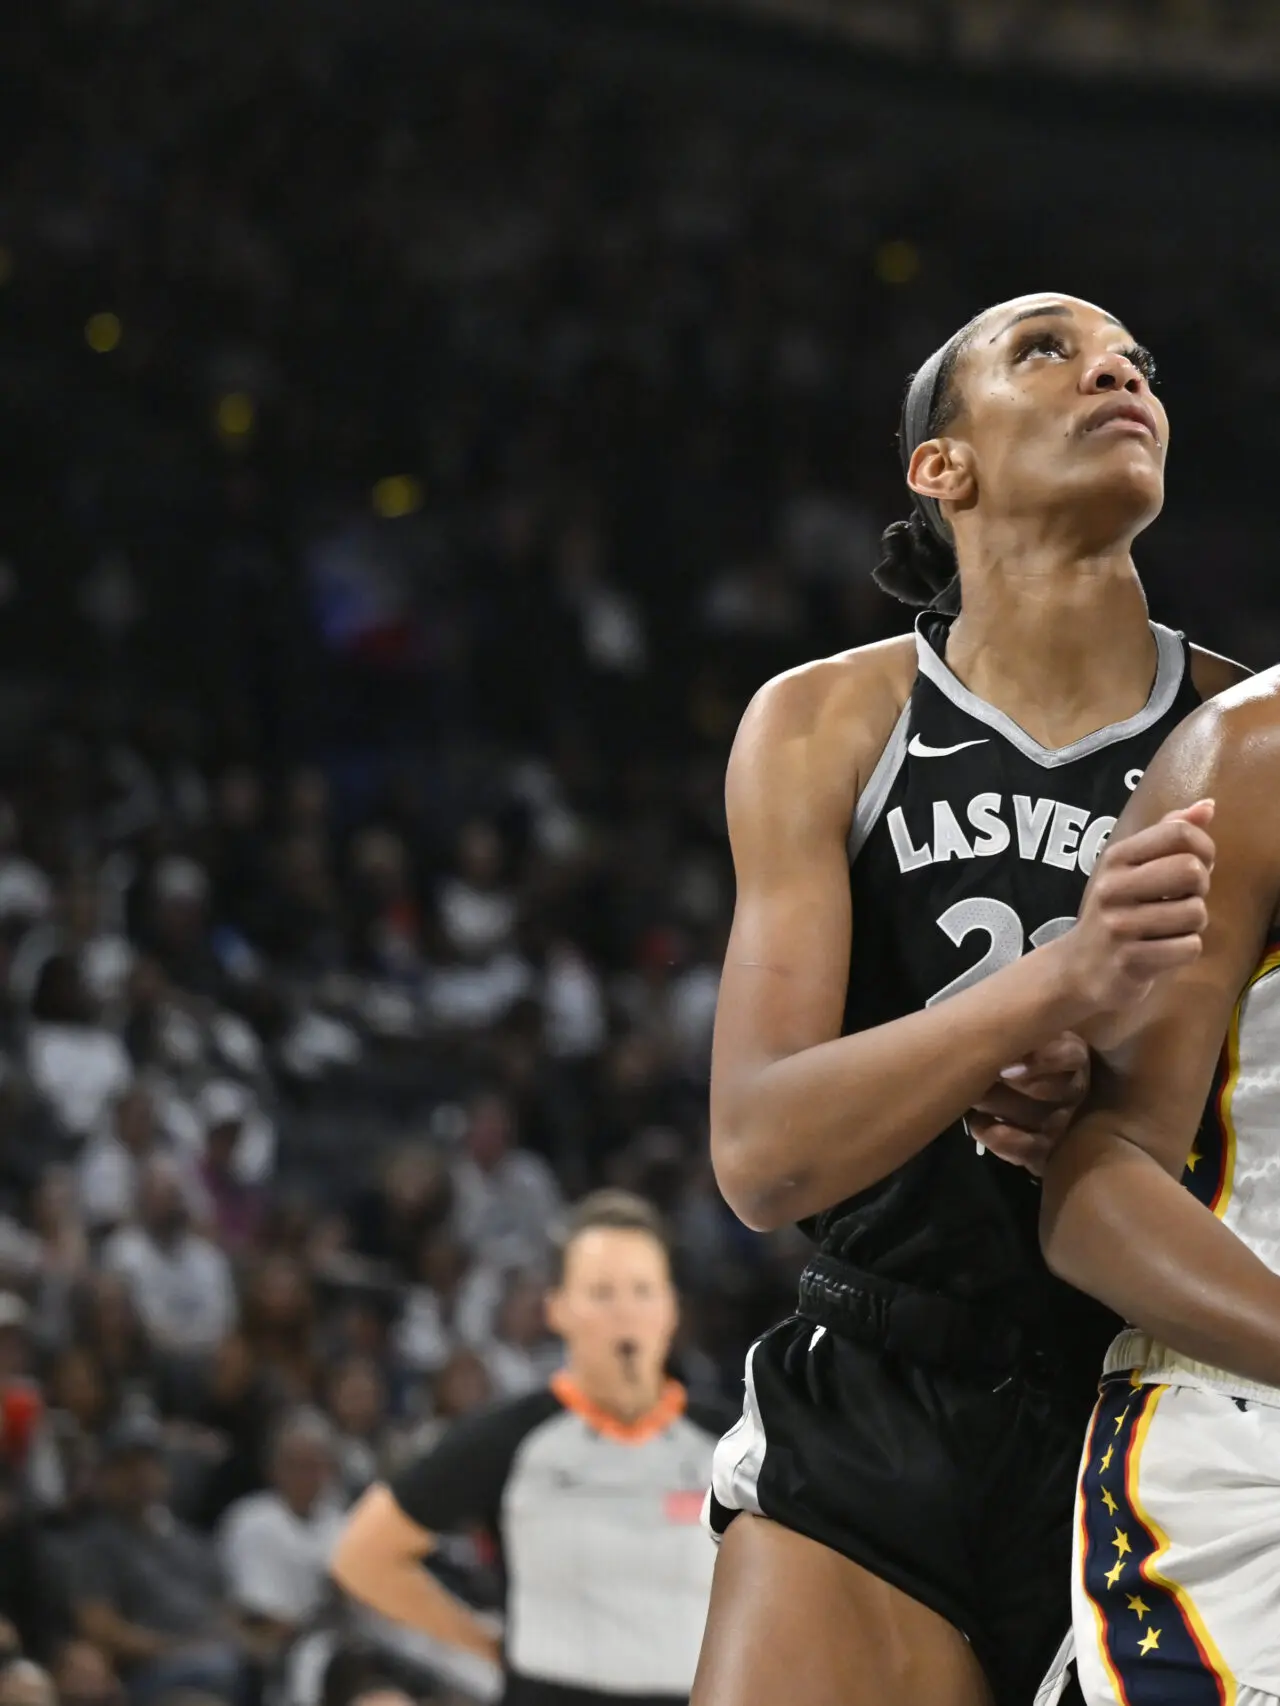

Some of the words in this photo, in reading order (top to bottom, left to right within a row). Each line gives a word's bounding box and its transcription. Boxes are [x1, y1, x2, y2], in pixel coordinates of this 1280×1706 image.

[886, 792, 1011, 874] LAS
[1012, 794, 1118, 877] VEG
[925, 897, 1078, 1009] 2
